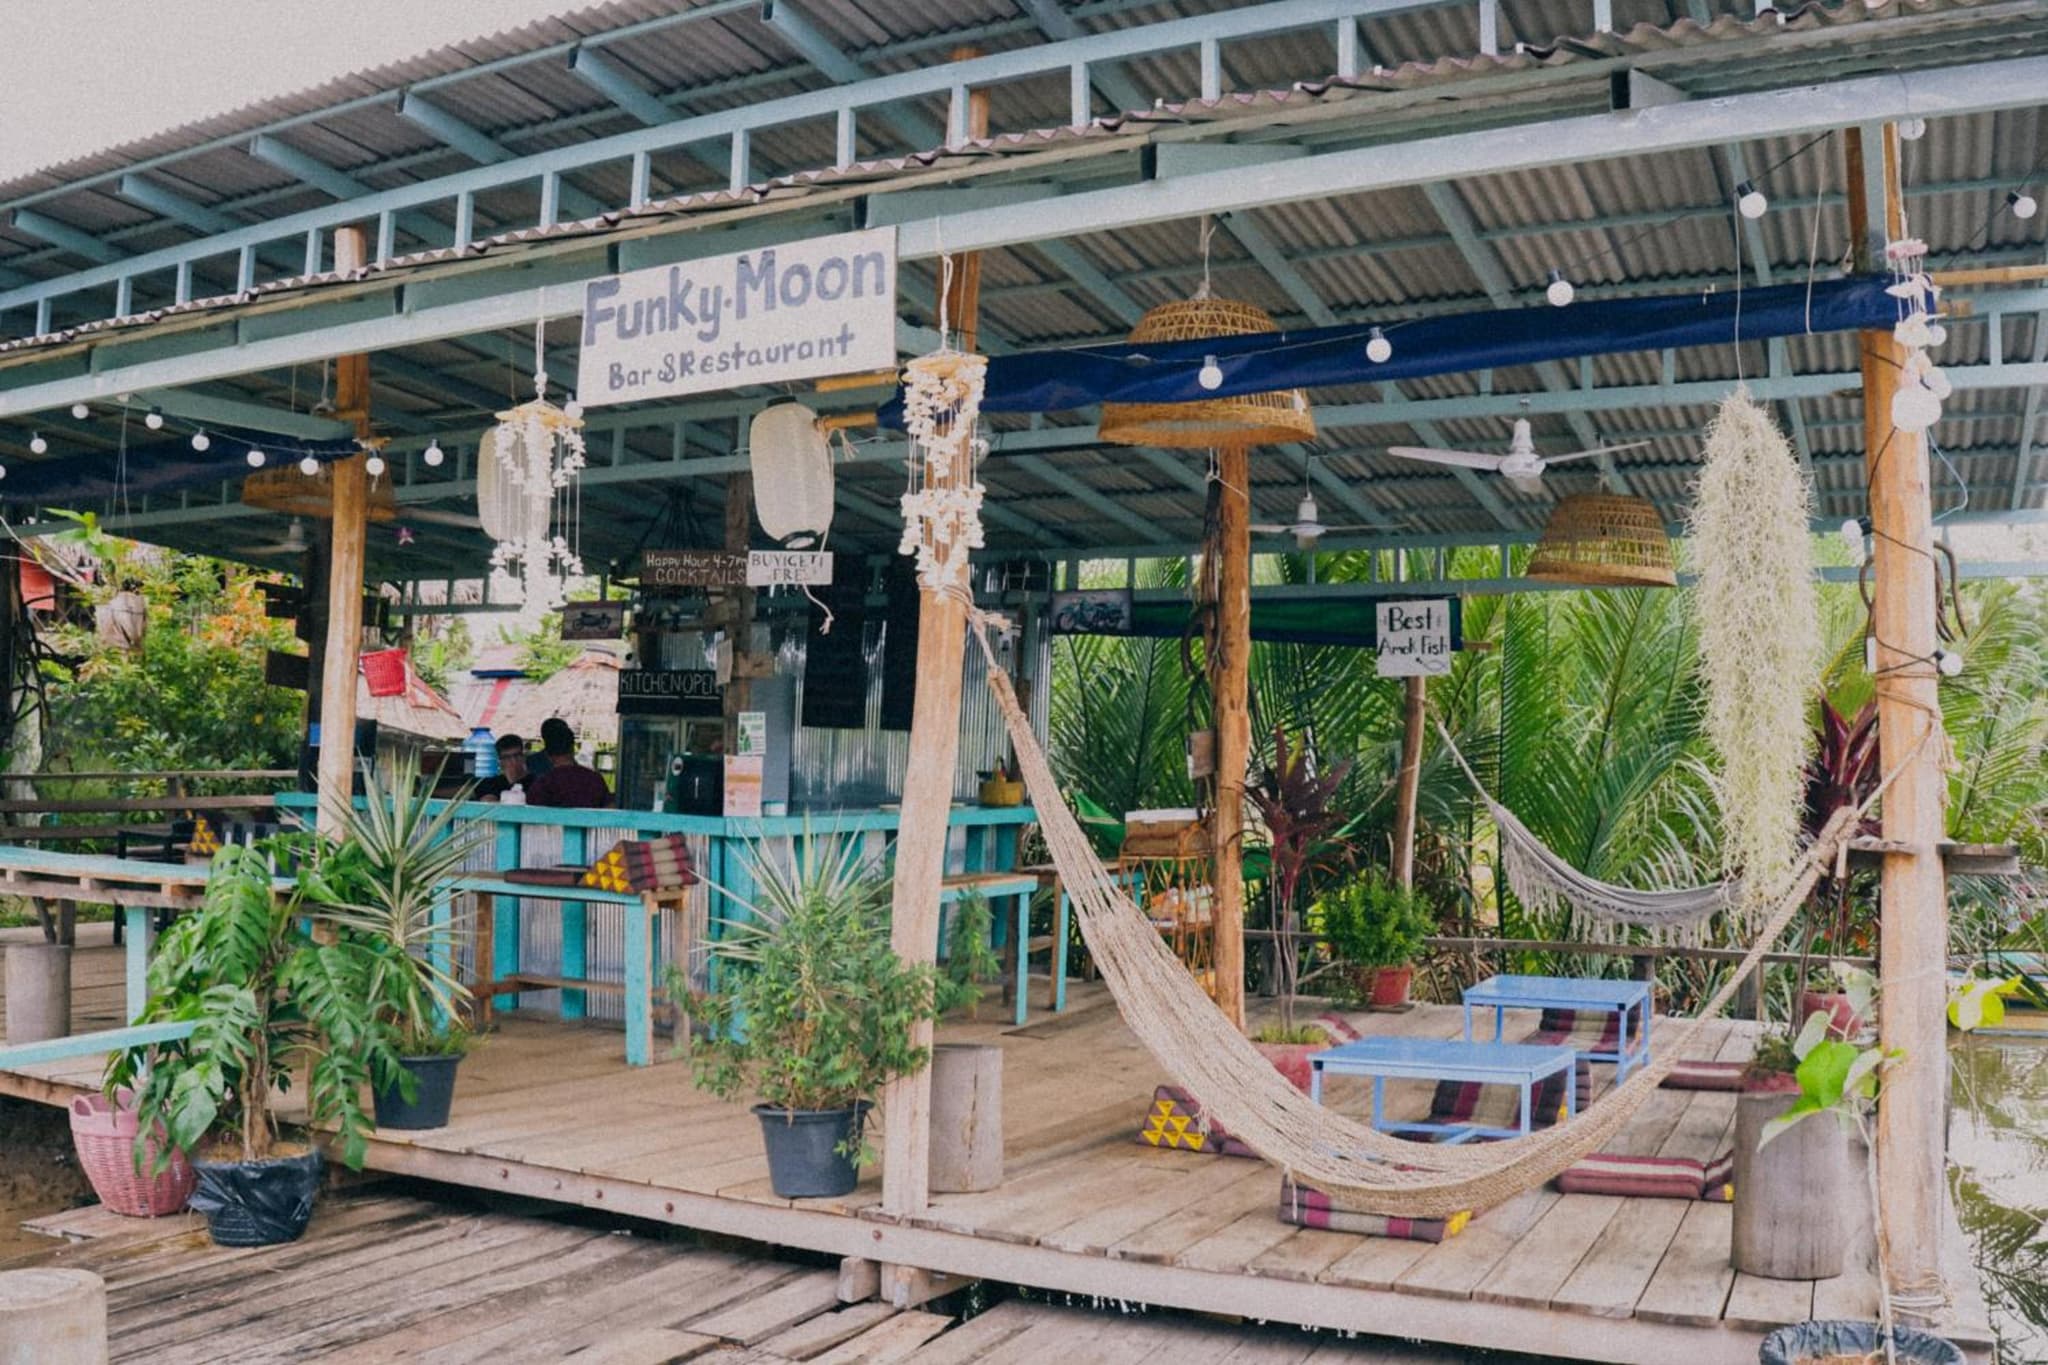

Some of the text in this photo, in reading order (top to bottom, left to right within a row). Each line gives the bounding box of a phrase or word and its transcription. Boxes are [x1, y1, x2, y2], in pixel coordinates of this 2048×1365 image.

[735, 249, 887, 321] Moon
[608, 361, 652, 391] Bar
[679, 322, 855, 378] Restaurant
[646, 552, 680, 568] Happy
[683, 553, 709, 567] Hour
[655, 567, 746, 585] COCKTAILS
[1388, 606, 1432, 633] Best
[1421, 635, 1448, 656] Fish
